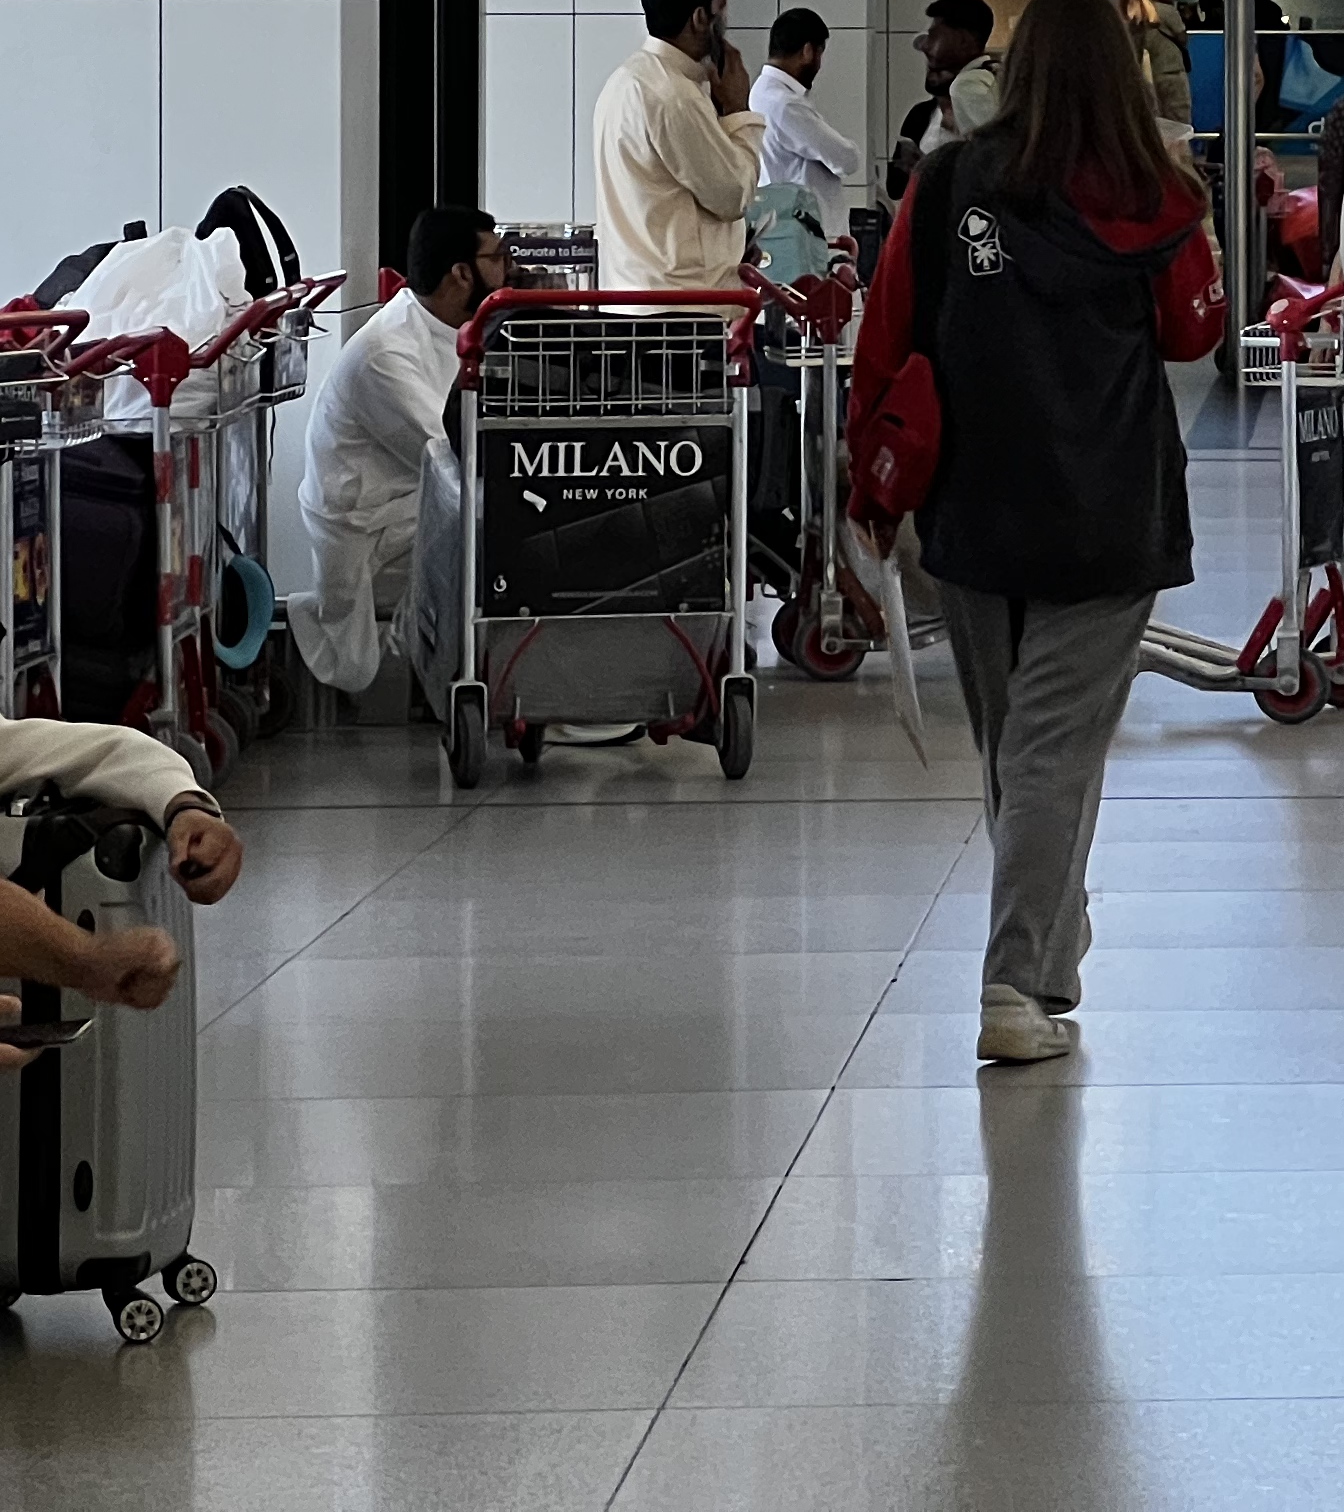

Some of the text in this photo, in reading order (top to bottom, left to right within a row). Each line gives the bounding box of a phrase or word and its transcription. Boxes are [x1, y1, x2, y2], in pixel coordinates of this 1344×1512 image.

[509, 245, 556, 257] Donate
[559, 245, 570, 257] to
[509, 440, 704, 478] MILANO
[562, 488, 649, 501] NEW YORK
